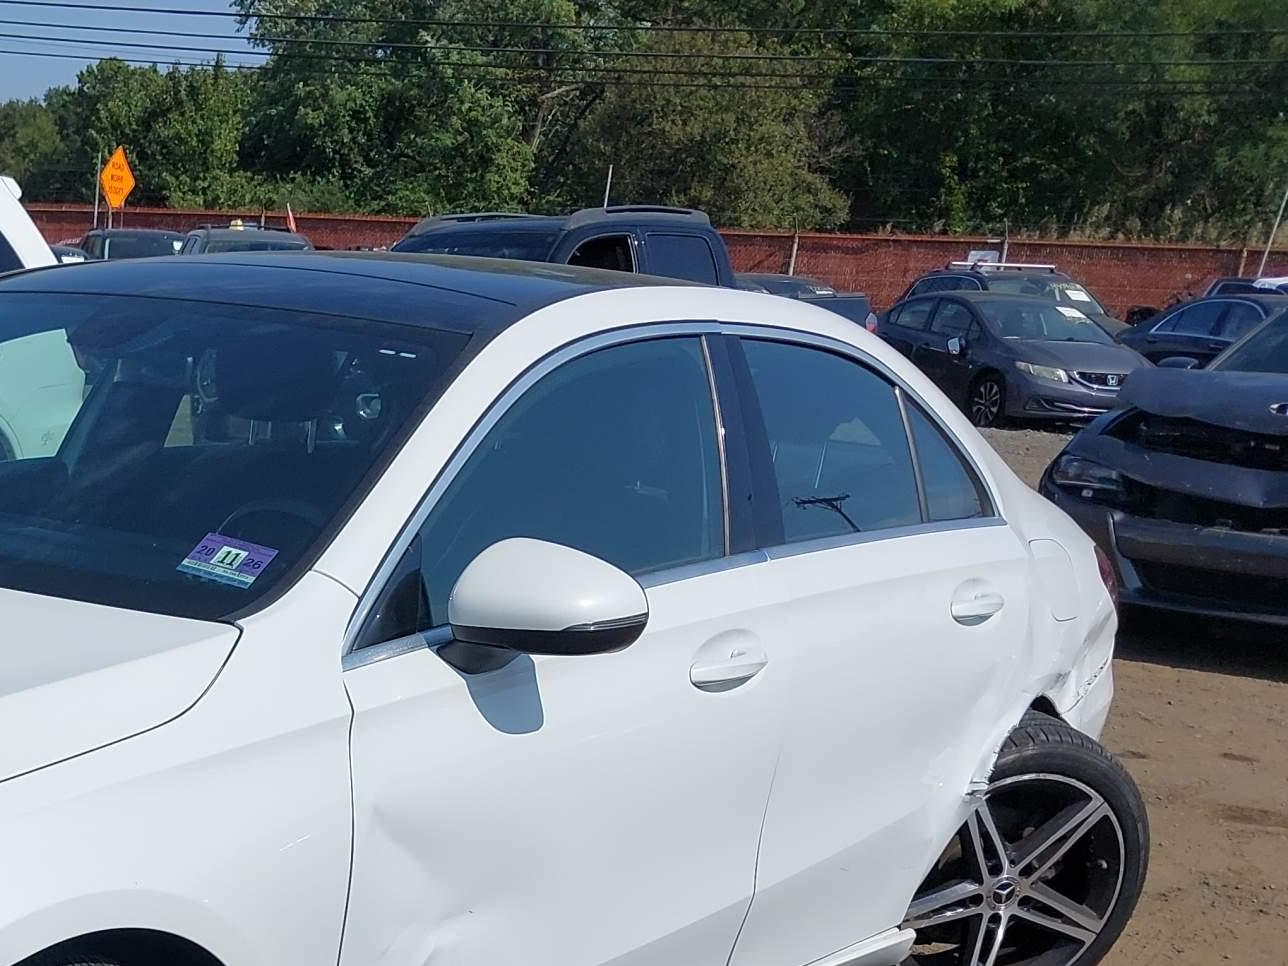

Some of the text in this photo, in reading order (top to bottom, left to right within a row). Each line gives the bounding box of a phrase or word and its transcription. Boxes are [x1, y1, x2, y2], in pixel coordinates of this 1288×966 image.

[197, 546, 263, 569] 20 11 26
